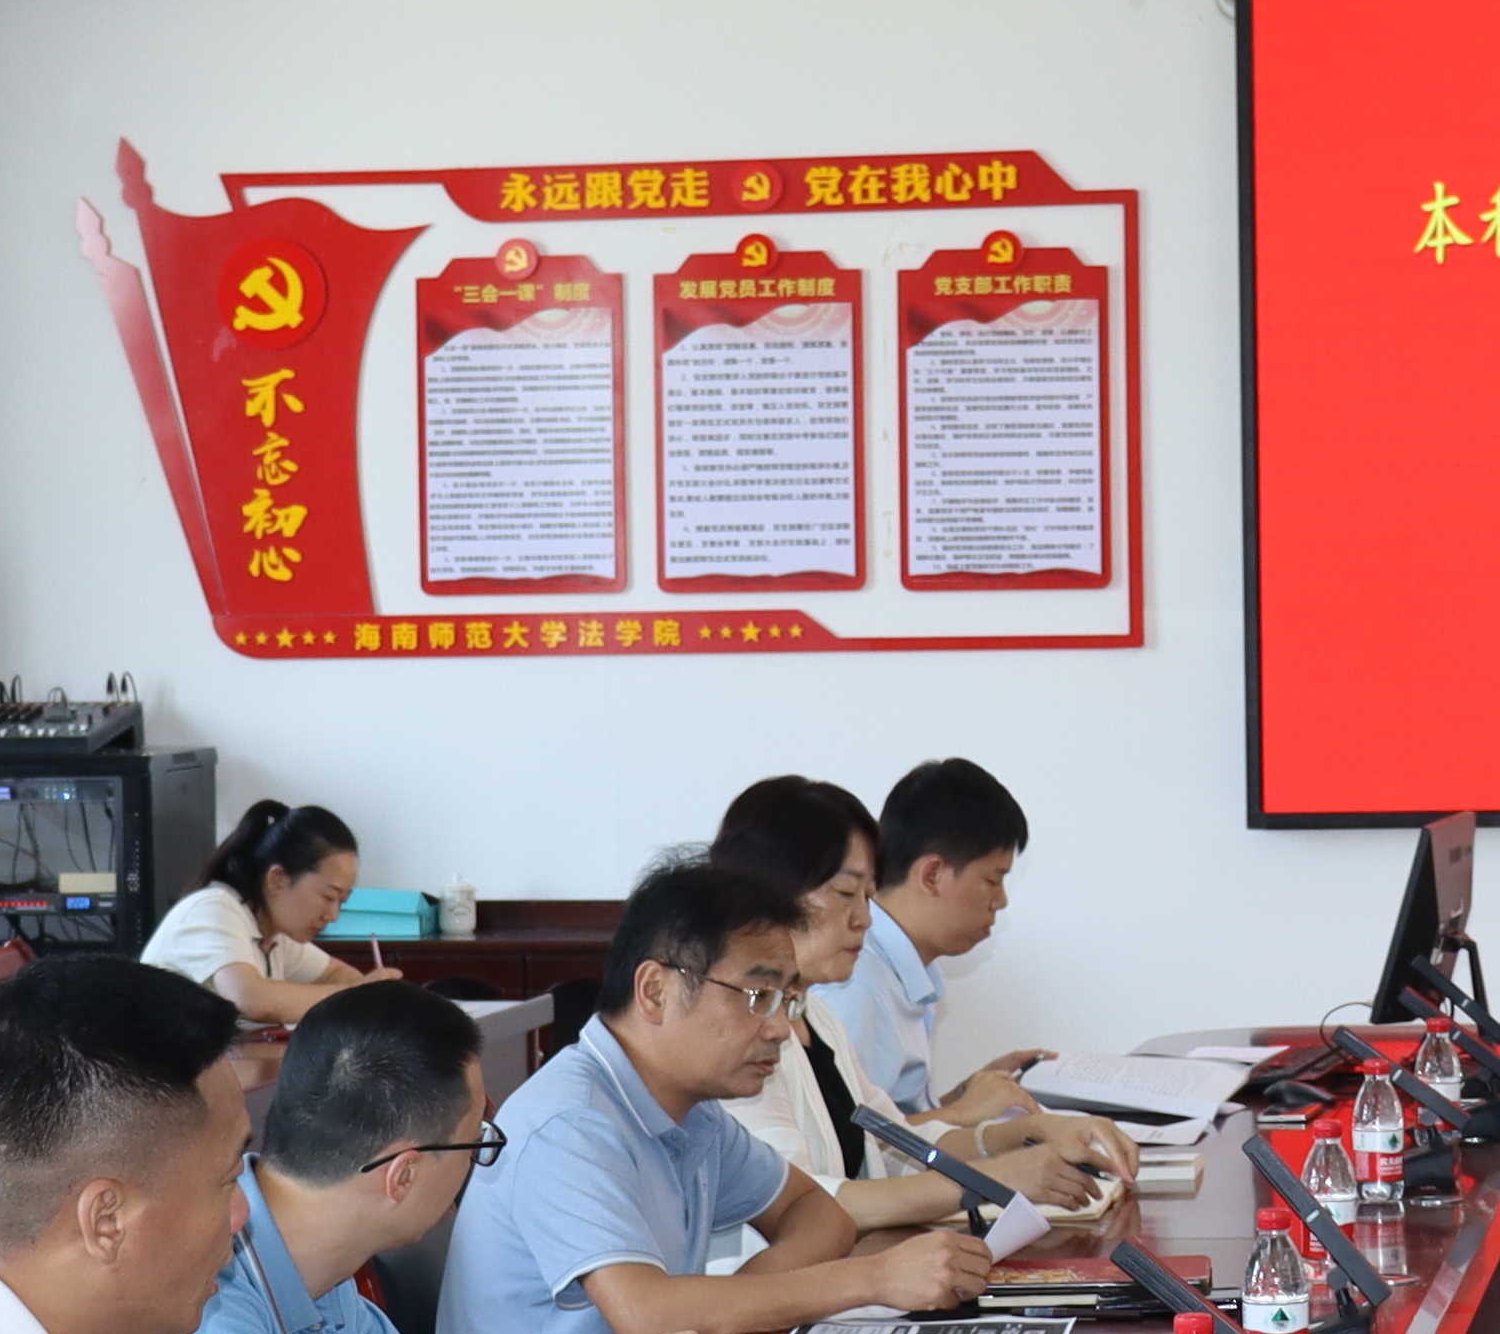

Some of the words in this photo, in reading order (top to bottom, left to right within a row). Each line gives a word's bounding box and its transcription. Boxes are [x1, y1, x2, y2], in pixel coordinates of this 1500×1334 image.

[499, 168, 710, 213] 永远跟党走
[804, 160, 1019, 206] 党在我心中
[679, 277, 836, 299] 发展党员工作制度
[934, 274, 1072, 296] 党支部工作职责
[241, 368, 308, 583] 不忘初心
[353, 619, 682, 652] 海南师范大学法学院
